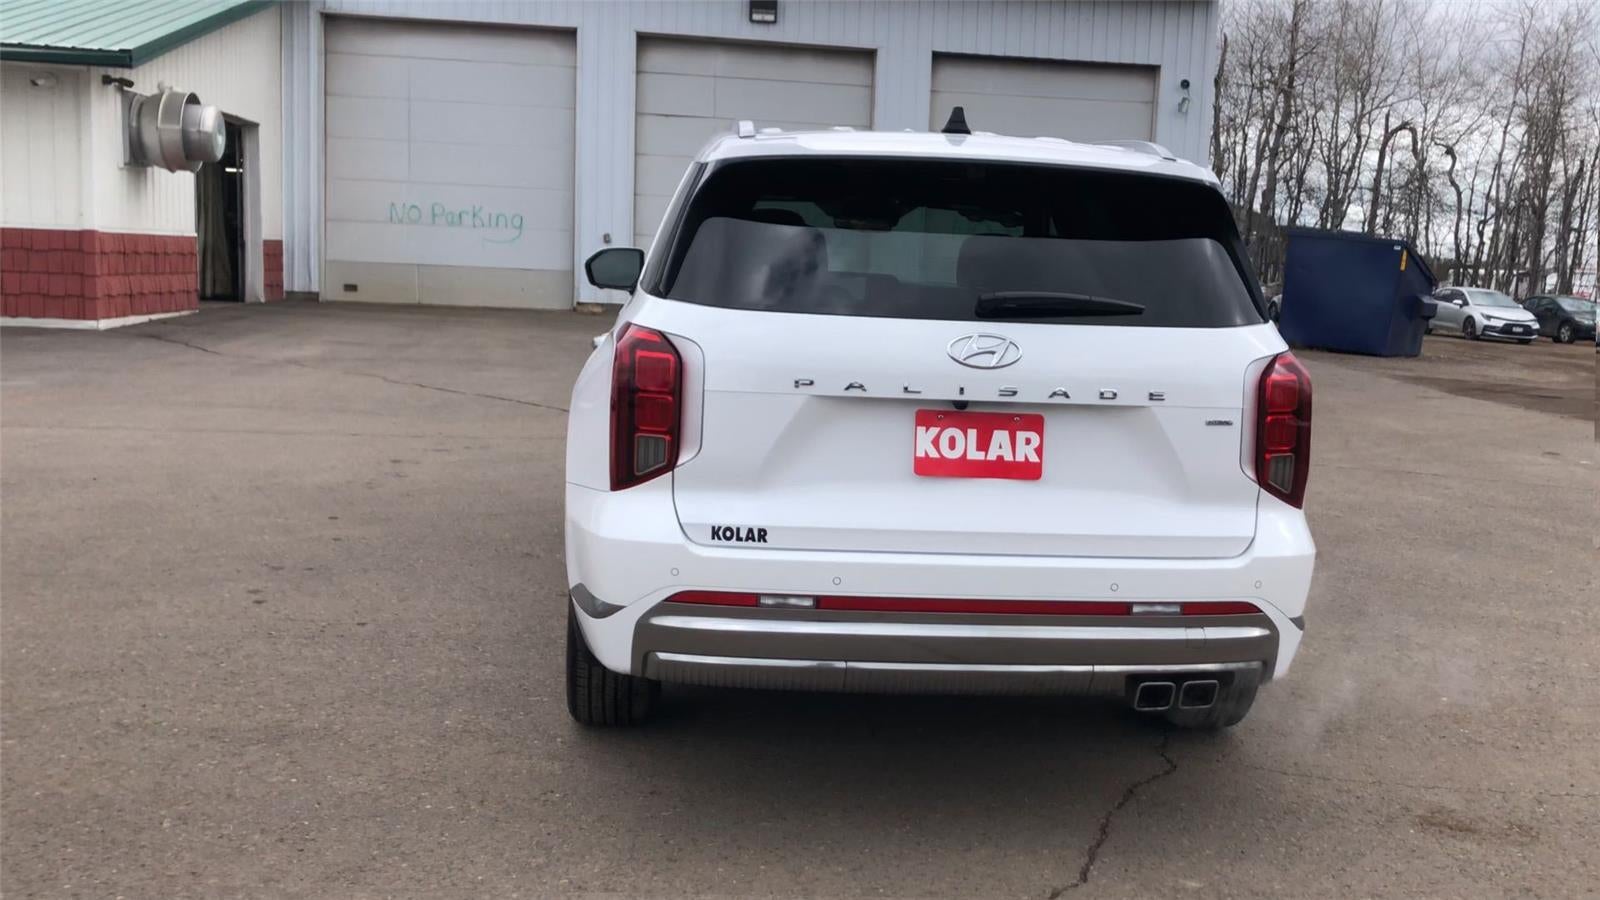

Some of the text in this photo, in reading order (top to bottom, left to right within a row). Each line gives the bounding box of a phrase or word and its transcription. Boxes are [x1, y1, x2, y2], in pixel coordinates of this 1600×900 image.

[794, 378, 1166, 401] PALISADE
[915, 426, 1041, 463] KOLAR
[711, 525, 768, 543] KOLAR
